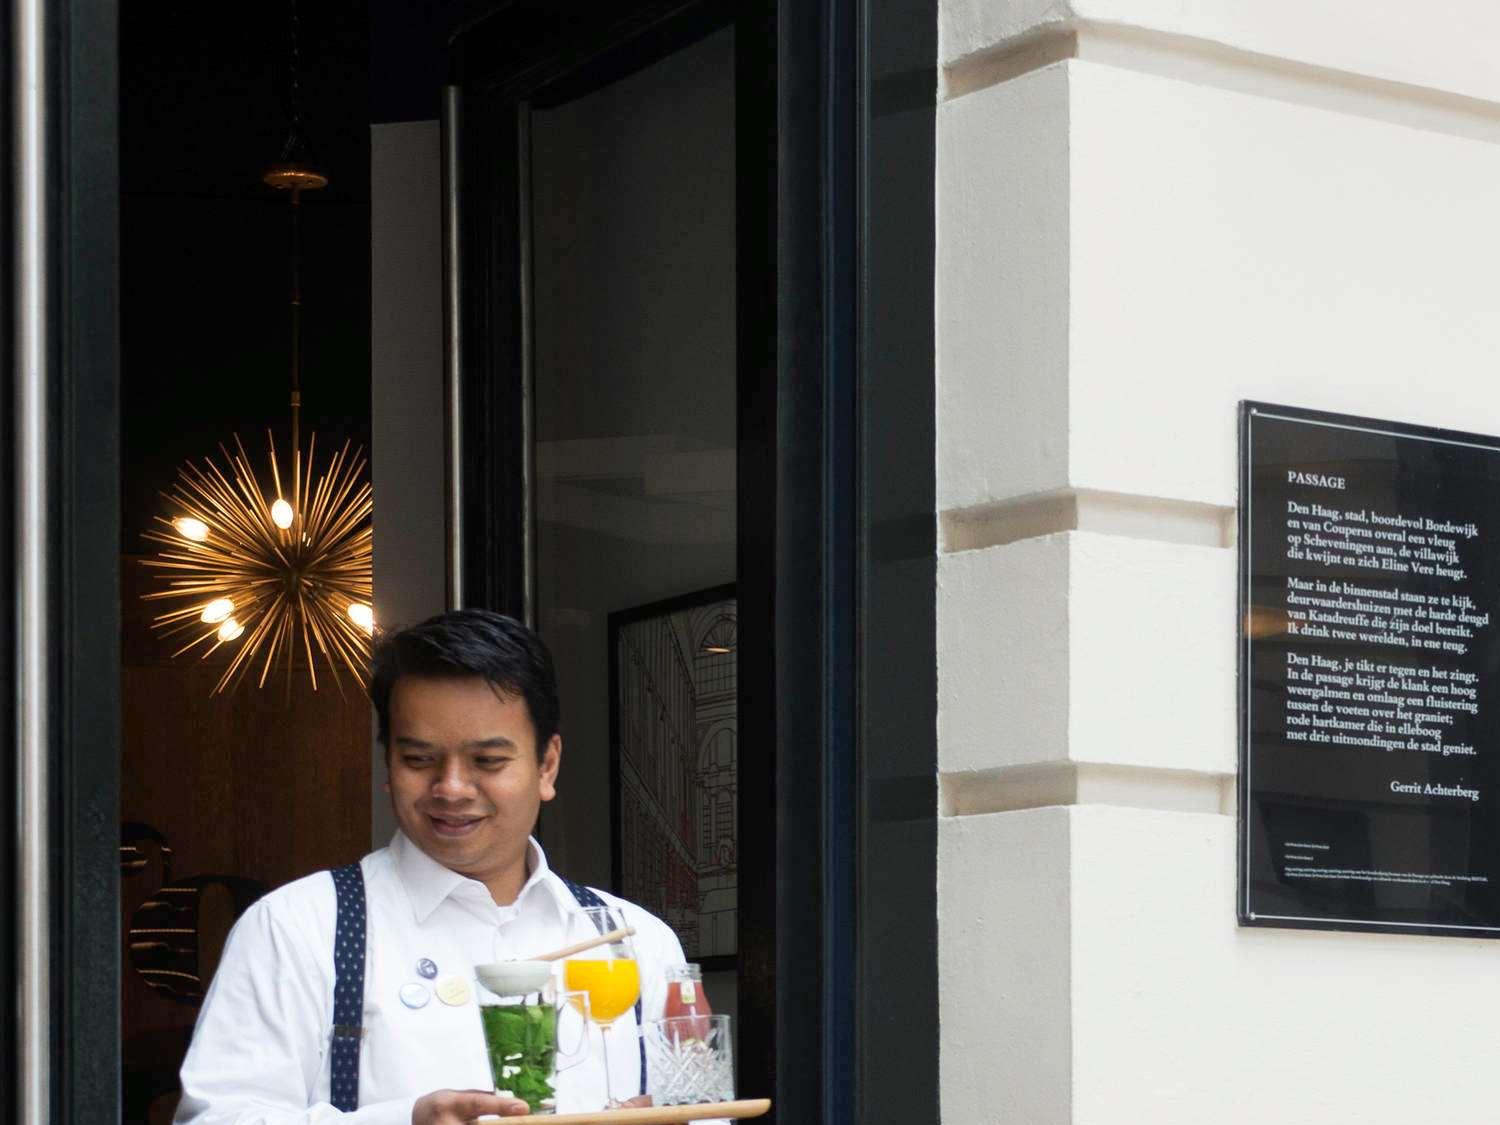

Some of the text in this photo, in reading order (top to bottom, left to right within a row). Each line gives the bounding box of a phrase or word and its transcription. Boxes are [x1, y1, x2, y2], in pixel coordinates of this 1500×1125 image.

[1287, 470, 1346, 490] PASSAGE
[1286, 519, 1456, 553] en van Couperus overal een vleug
[1287, 500, 1479, 539] Den Haag, stad, boordevol Bordewijk
[1286, 545, 1468, 582] die kwijnt en zich Eline Vere heugt.
[1287, 533, 1460, 566] op Scheveningen aan, de villawijk
[1286, 590, 1490, 628] deurwaardershuizen met de harde deugd
[1287, 576, 1477, 613] Maar in de binnenstad staan ze te kijk,
[1286, 621, 1468, 656] Ik drink twee werelden, in ene teug.
[1287, 609, 1474, 638] van Katadreuffe die zijn doel bereikt.
[1286, 651, 1480, 685] Den Haag, je tikt er tegen en het zingt.
[1287, 667, 1477, 700] In de passage krijgt de klank een hoog
[1286, 685, 1479, 715] weergalmen en omlaag een fluistering
[1286, 699, 1454, 726] tussen de voeten over het graniet;
[1286, 713, 1442, 742] rode hartkamer die in elleboog
[1286, 729, 1477, 757] met drie uitmondingen de stad geniet.
[1389, 780, 1480, 802] Gerrit Achterberg
